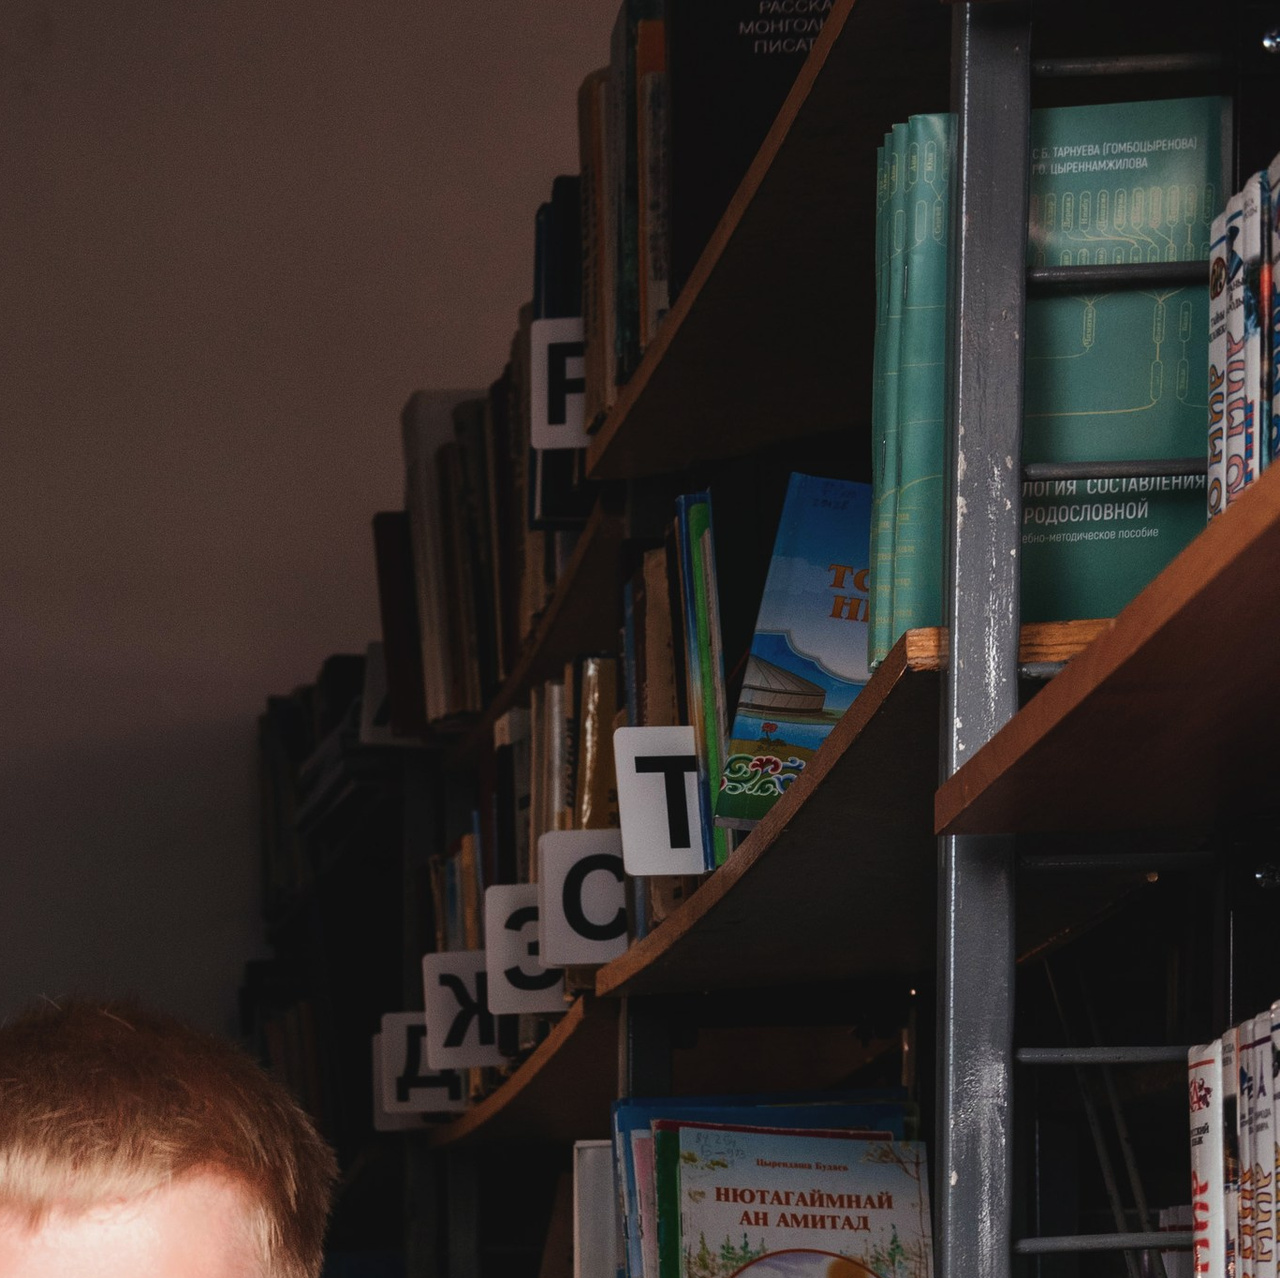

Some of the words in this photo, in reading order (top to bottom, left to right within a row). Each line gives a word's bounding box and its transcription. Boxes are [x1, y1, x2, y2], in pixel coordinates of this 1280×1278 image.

[1053, 143, 1100, 158] ТАРНУЕВА
[1103, 137, 1197, 156] (ГОМБОЦЫРЕНОВА)
[1051, 157, 1148, 175] ЦЫРЕННАМЖИЛОВА
[1024, 498, 1149, 526] РОДОСЛОВНОЙ
[1118, 527, 1159, 539] пособие
[634, 755, 697, 849] Т
[562, 853, 628, 941] С
[715, 1187, 894, 1210] НЮТАГАЙМНАЙ
[739, 1210, 769, 1227] АН
[776, 1212, 871, 1232] АМИТАД
